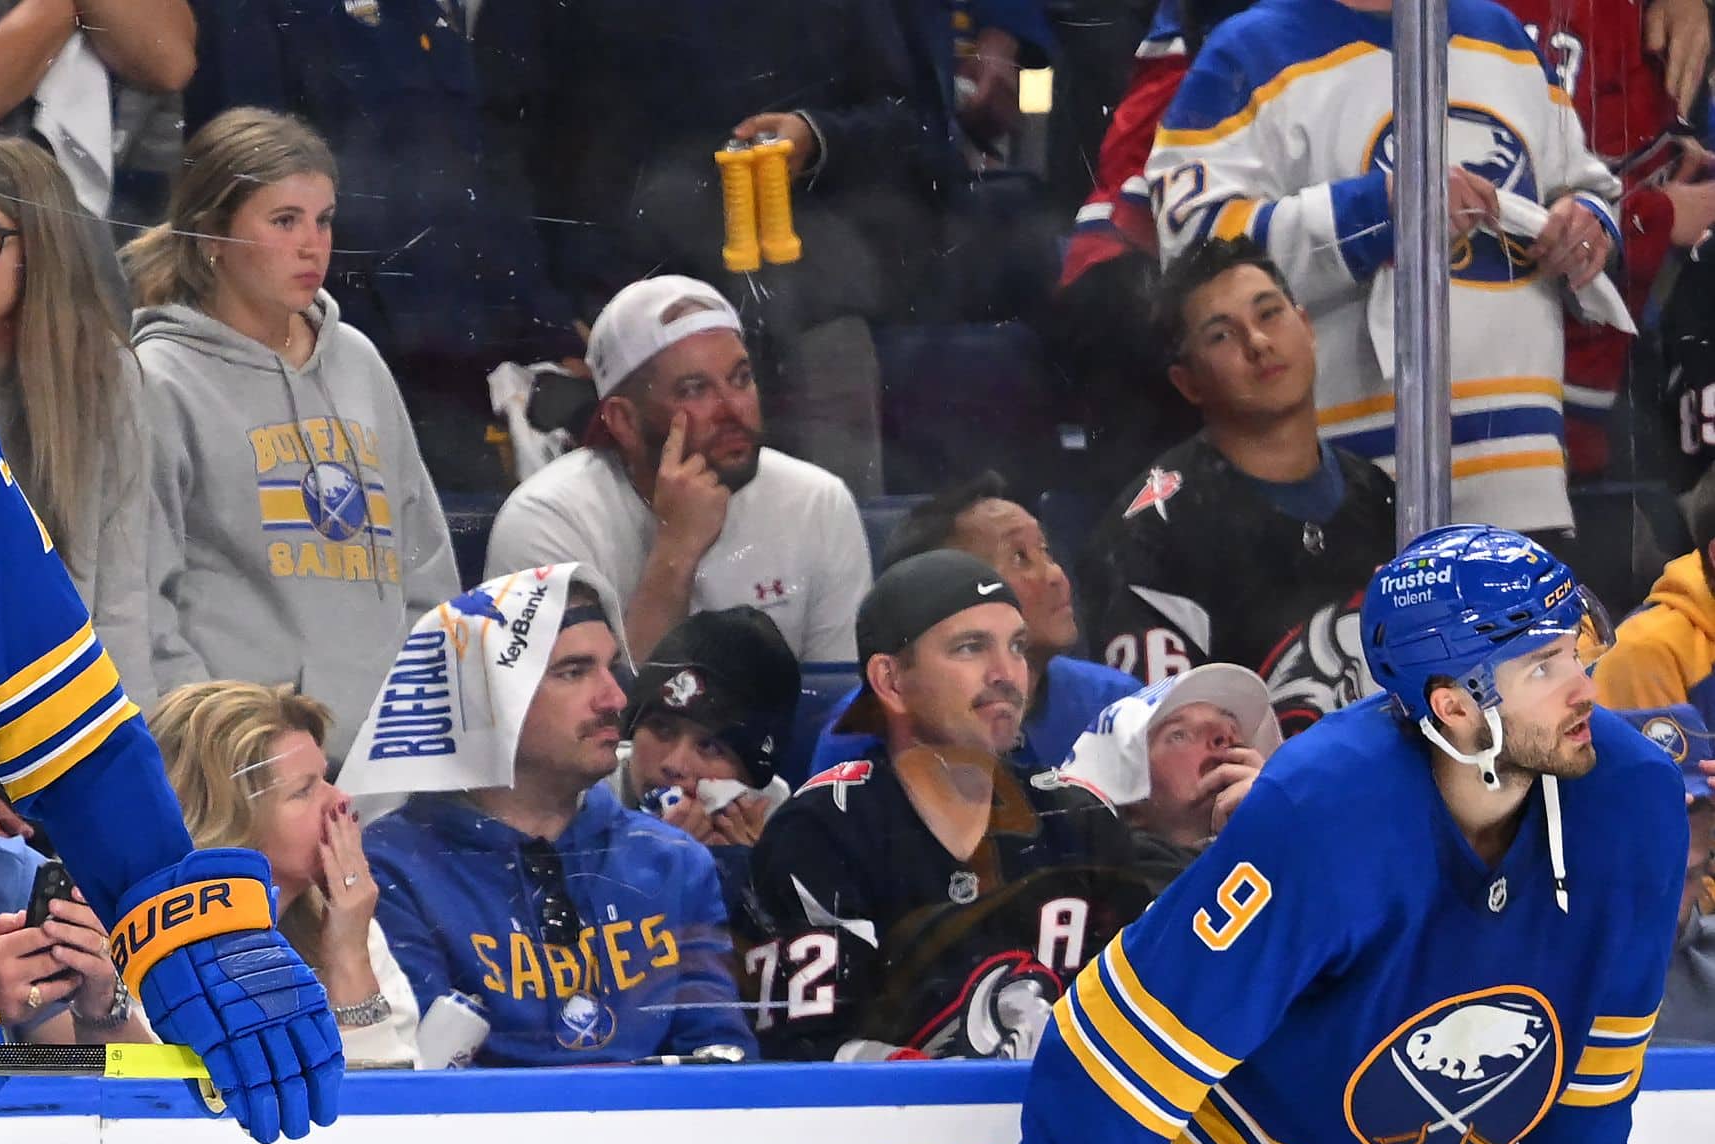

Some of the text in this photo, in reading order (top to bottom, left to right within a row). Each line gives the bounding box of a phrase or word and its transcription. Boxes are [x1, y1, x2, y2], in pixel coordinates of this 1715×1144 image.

[1381, 565, 1452, 595] Trusted
[1393, 588, 1433, 608] talent
[1544, 577, 1573, 609] CCM
[496, 584, 548, 669] KeyBank
[367, 630, 457, 761] BUFFALO
[1036, 897, 1089, 970] A
[1193, 861, 1272, 952] 9
[745, 931, 836, 1032] 72
